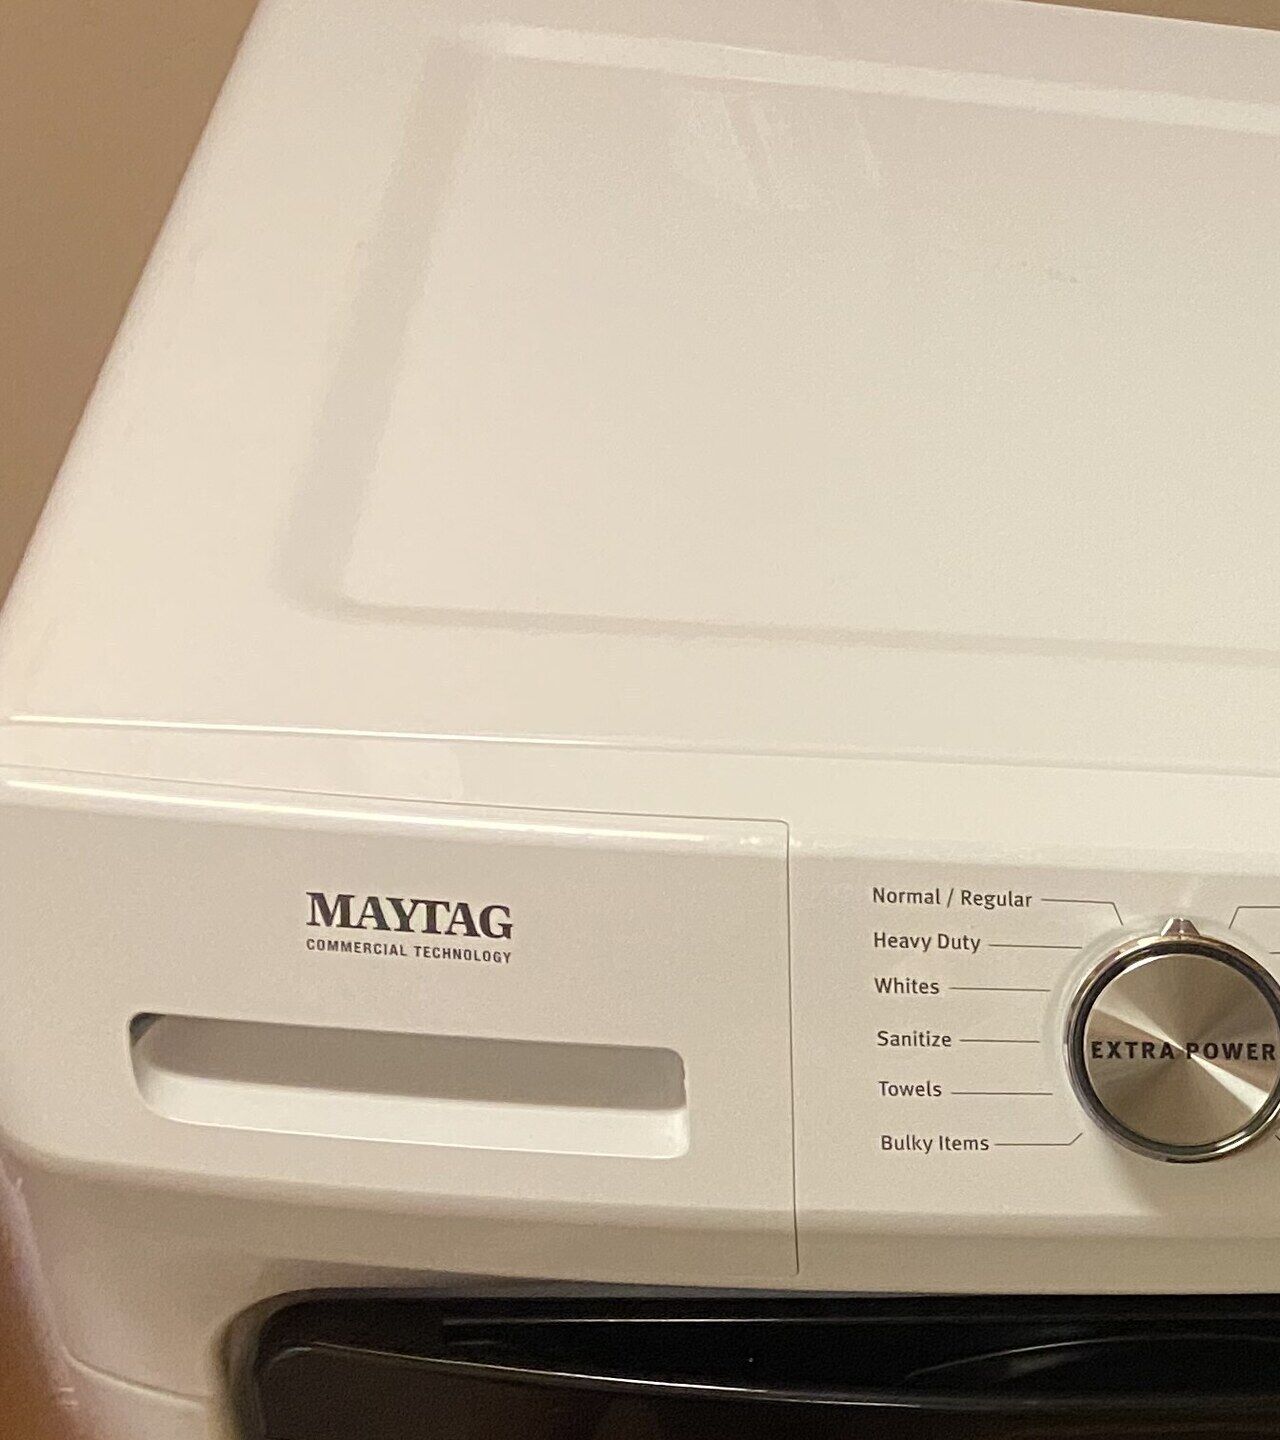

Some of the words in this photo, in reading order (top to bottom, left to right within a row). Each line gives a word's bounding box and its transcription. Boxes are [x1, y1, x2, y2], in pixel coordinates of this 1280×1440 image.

[872, 887, 940, 905] Normal
[961, 889, 1032, 911] Regular
[306, 891, 514, 940] MAYTAG
[306, 938, 407, 957] COMMERCIAL
[414, 945, 513, 964] TECHNOLOGY
[873, 932, 932, 953] Heavy
[938, 933, 981, 954] Duty
[874, 977, 940, 996] Whites
[877, 1029, 952, 1049] Sanitize
[1091, 1040, 1175, 1061] EXTRA
[1186, 1042, 1277, 1062] POWER
[879, 1080, 942, 1098] Towels
[881, 1134, 934, 1156] Bulky
[939, 1134, 990, 1153] Items
